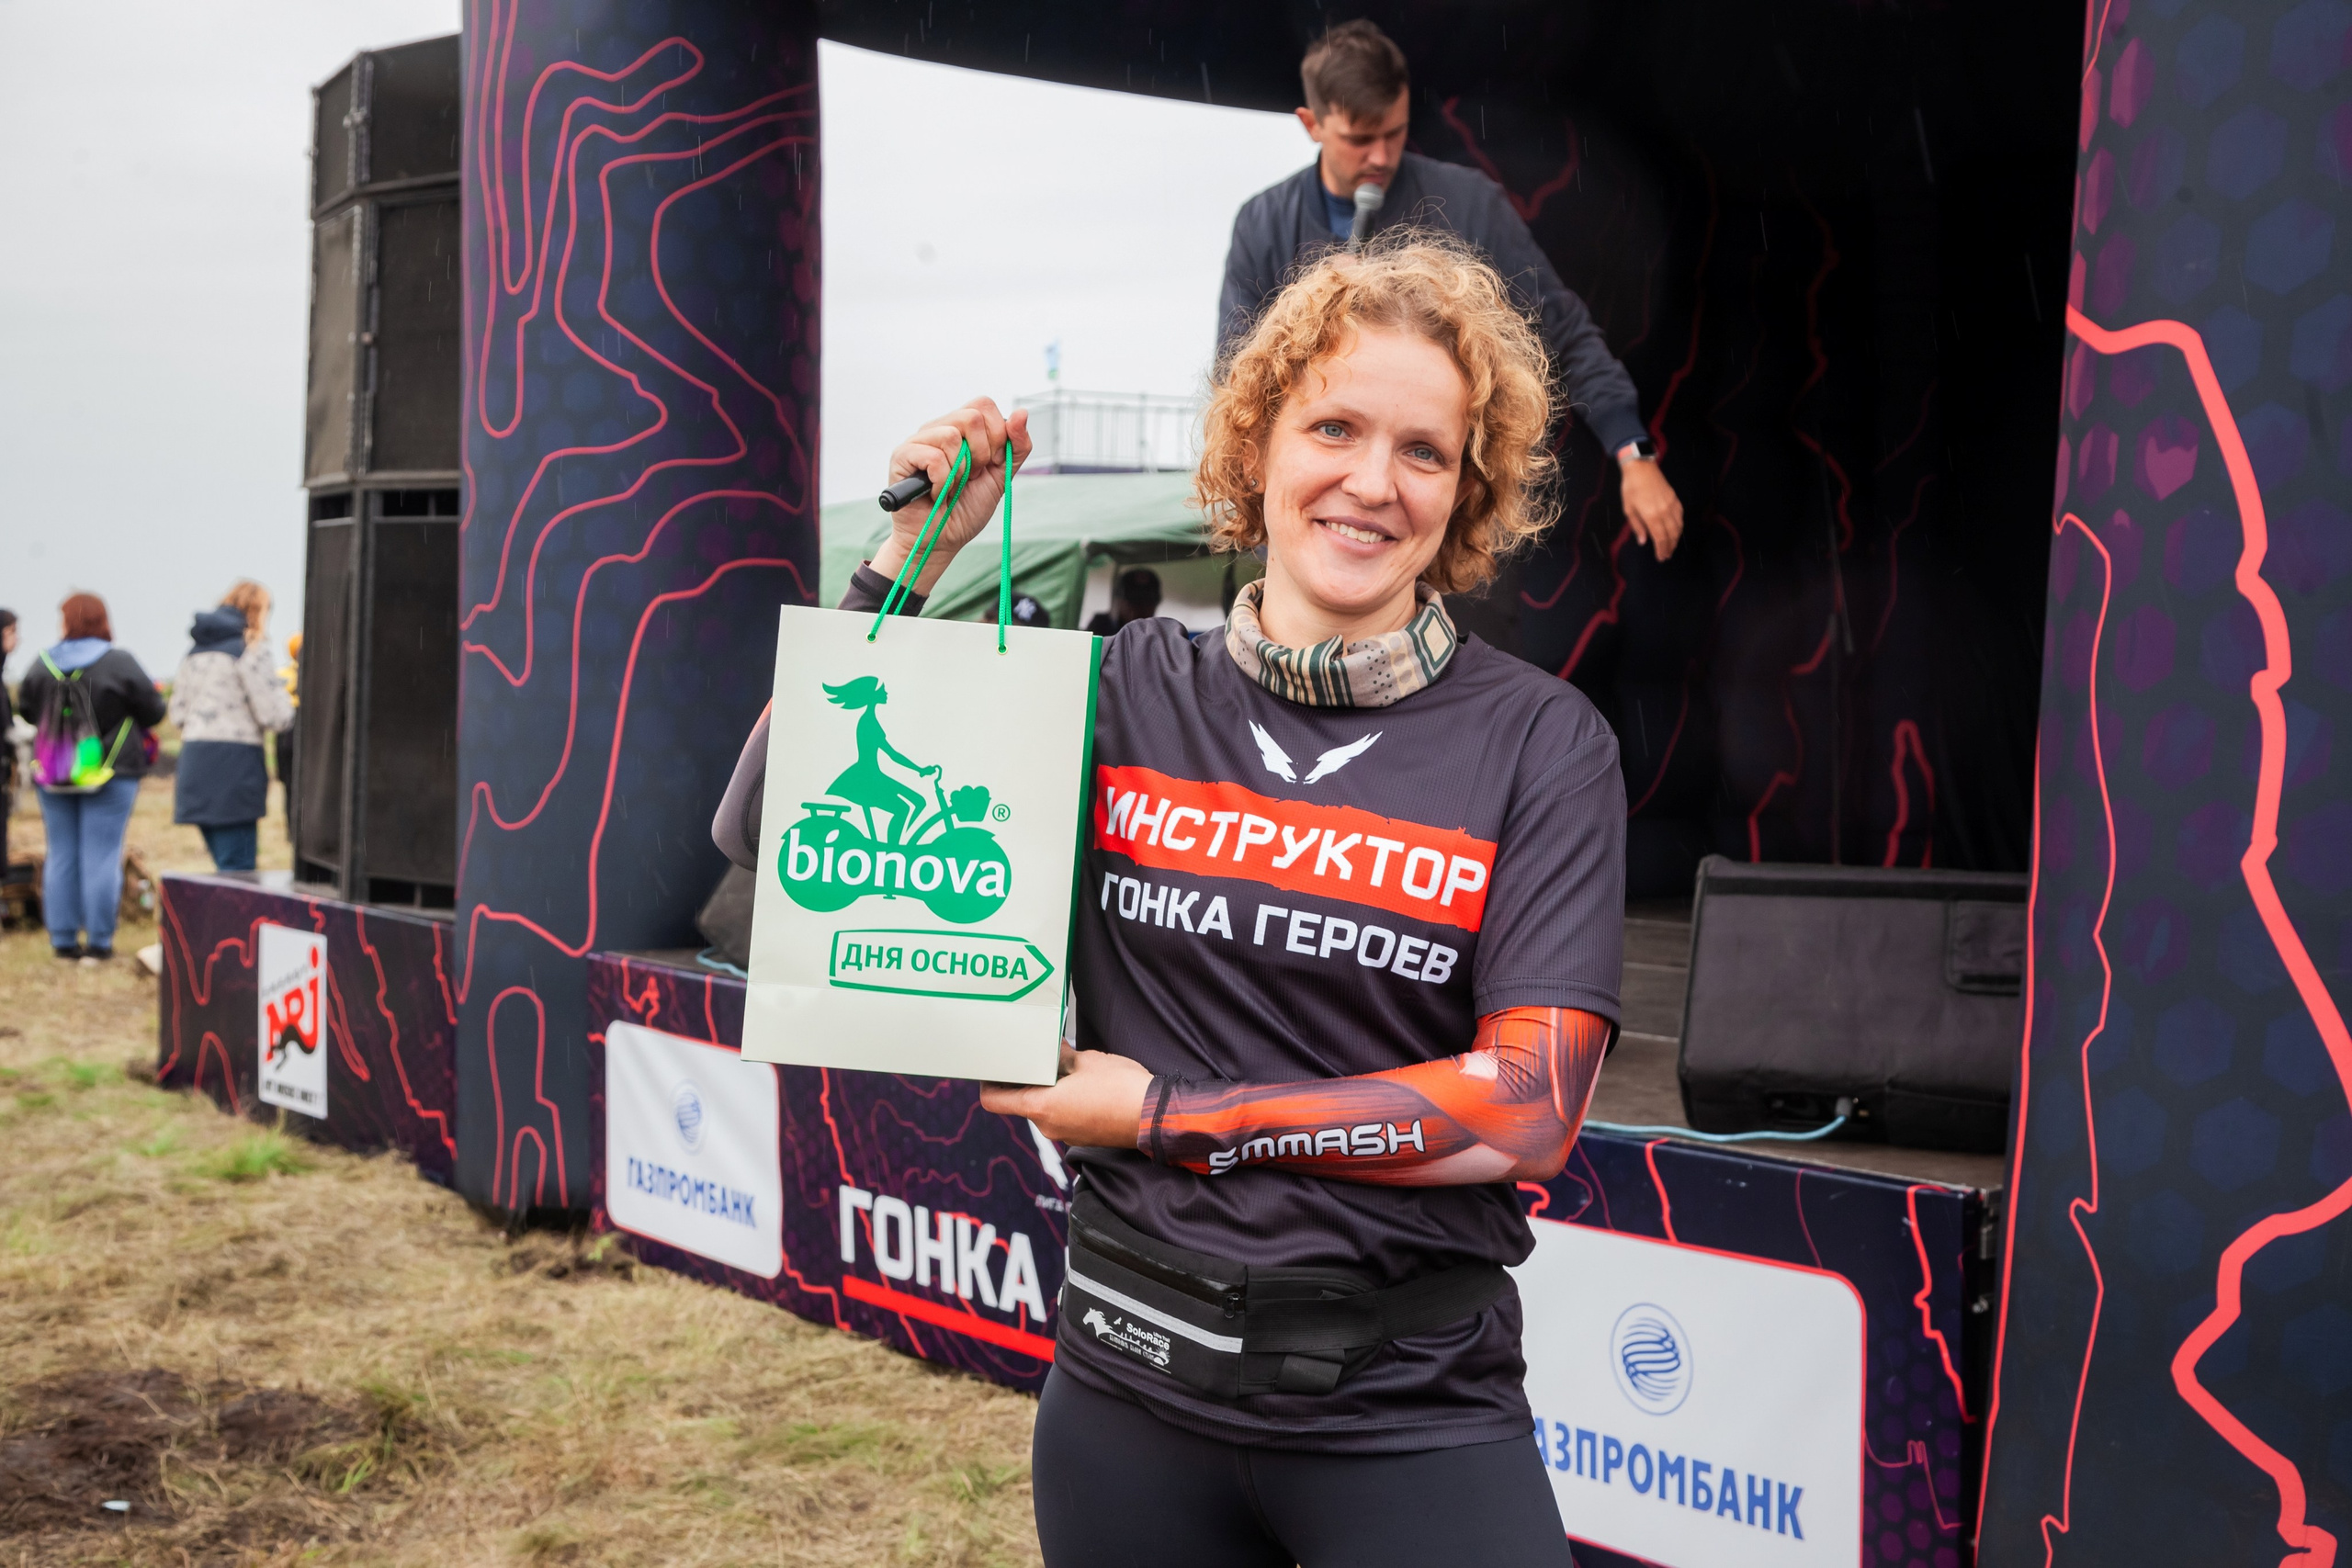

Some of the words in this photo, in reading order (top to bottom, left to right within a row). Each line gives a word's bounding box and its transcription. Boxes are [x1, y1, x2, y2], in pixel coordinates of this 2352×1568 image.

[786, 828, 1007, 898] bionova
[1105, 786, 1487, 908] ИНСТРУКТОР
[841, 942, 903, 971] ДНЯ
[910, 948, 1030, 982] ОСНОВА
[1100, 871, 1234, 941] ГОНКА
[1252, 903, 1460, 985] ГЕРОЕВ
[1208, 1119, 1425, 1176] SMMASH
[627, 1156, 757, 1229] ГАЗПРОМБАНК
[839, 1184, 1047, 1323] ГОНКА
[1126, 1323, 1170, 1351] SoloRace
[1533, 1416, 1806, 1542] АЗПРОМБАНК
